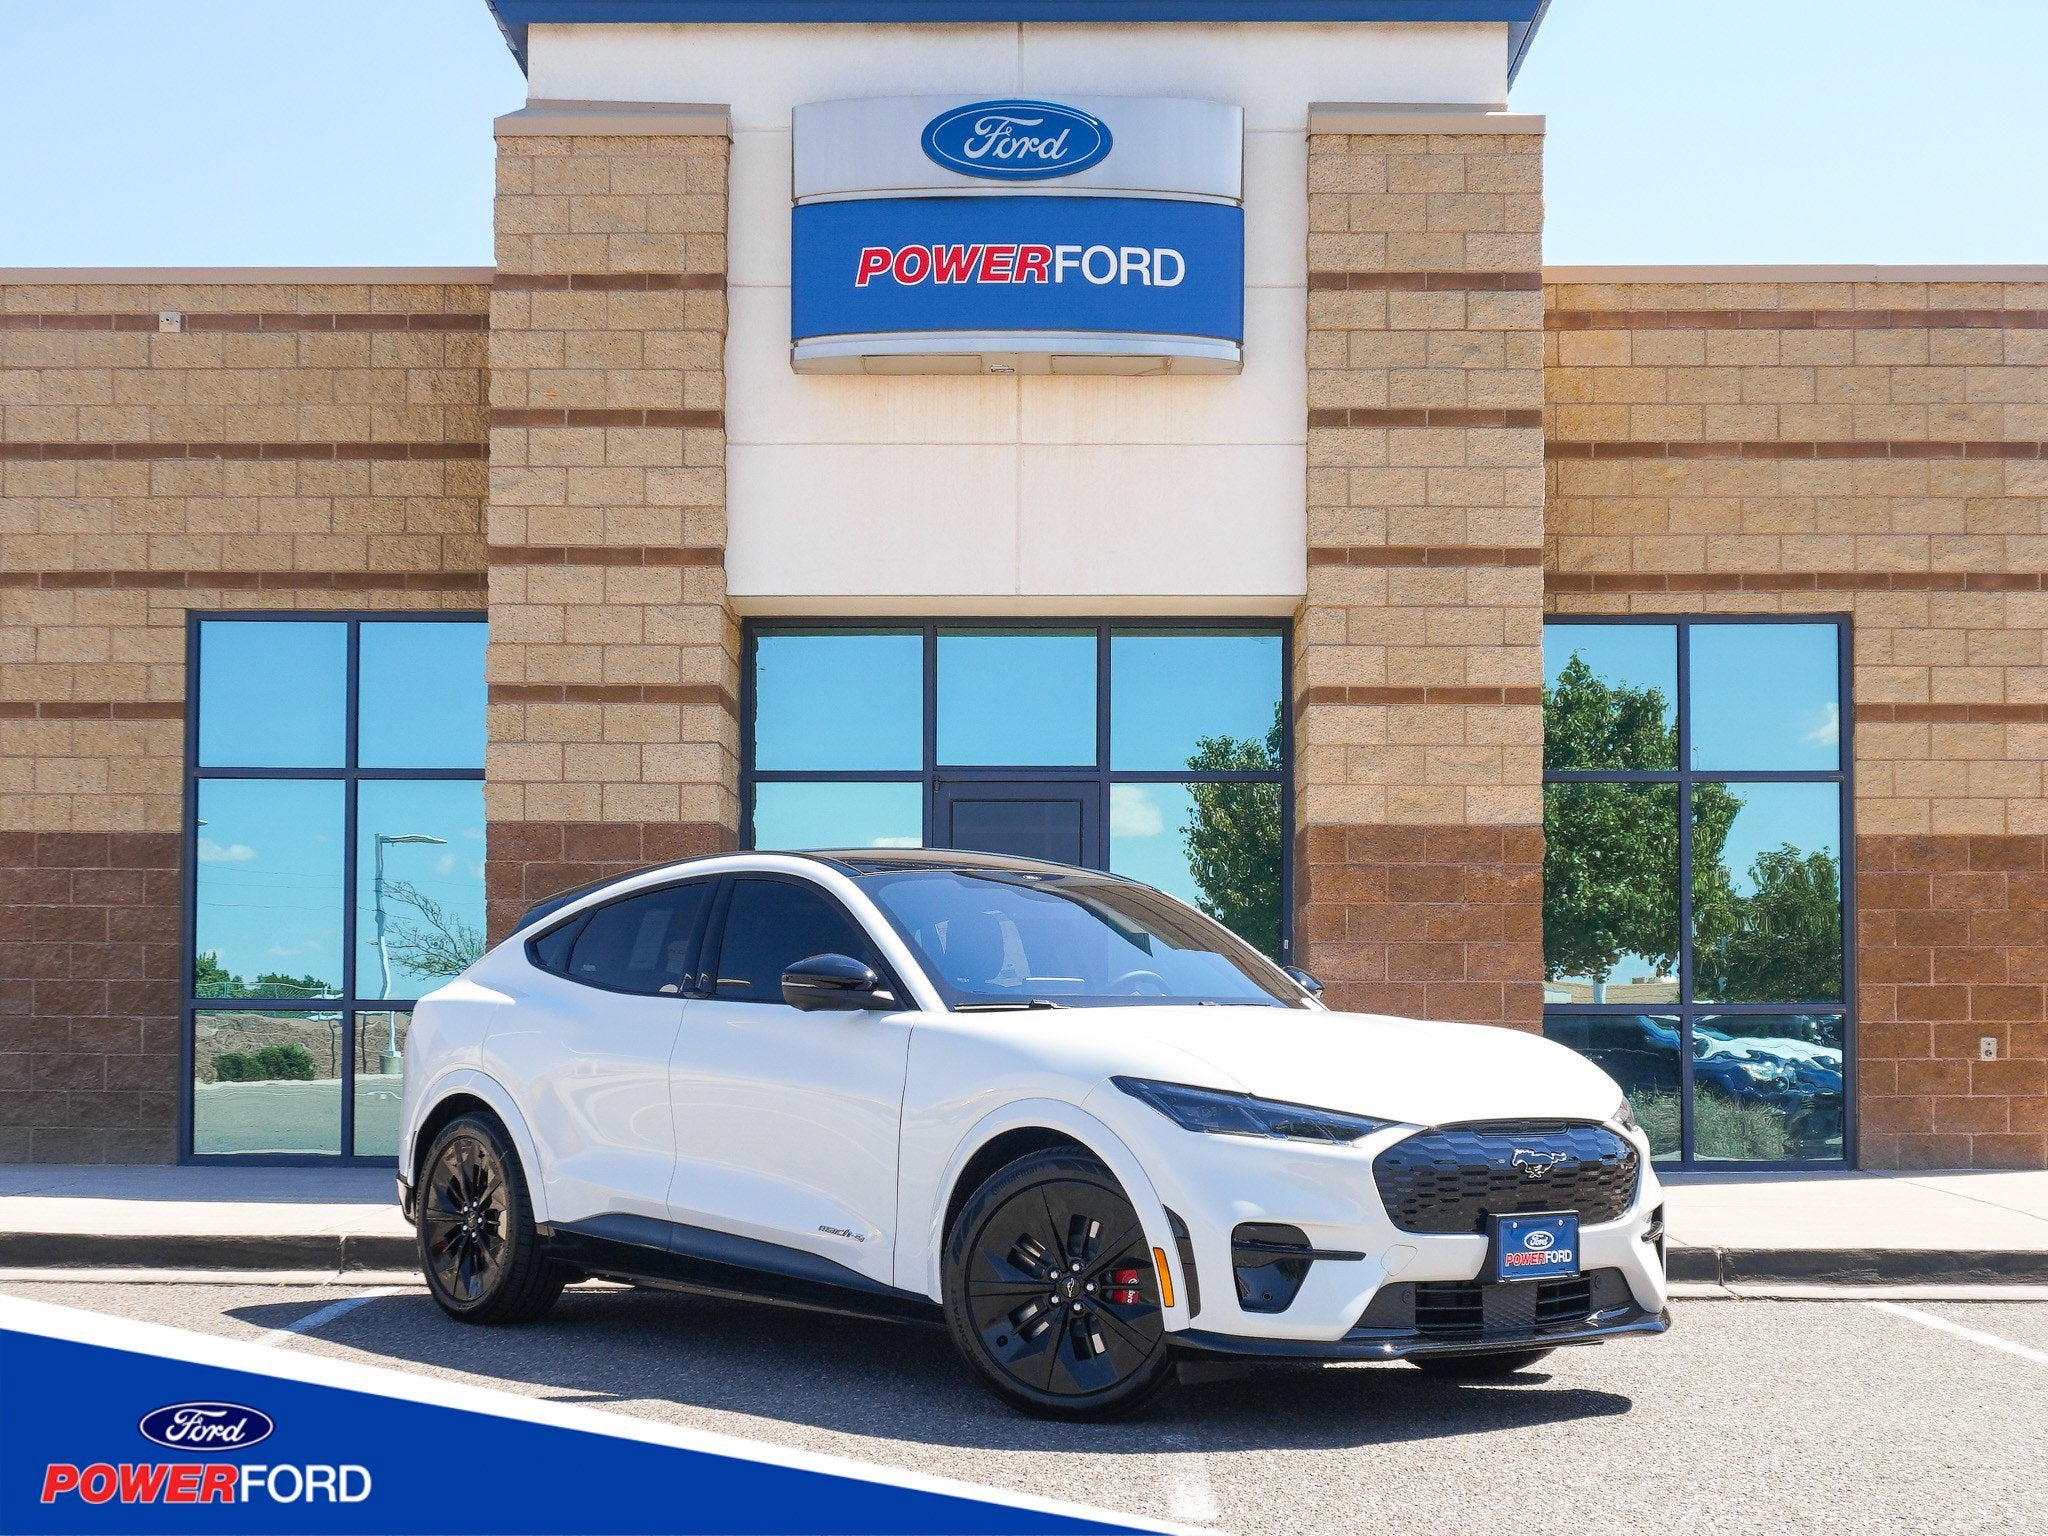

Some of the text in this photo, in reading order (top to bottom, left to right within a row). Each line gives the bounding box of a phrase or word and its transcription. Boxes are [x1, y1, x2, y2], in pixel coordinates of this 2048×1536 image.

[963, 115, 1069, 160] Ford
[855, 243, 1186, 288] POWERFORD
[1529, 1234, 1549, 1246] Ford
[1505, 1249, 1572, 1267] POWERFORD
